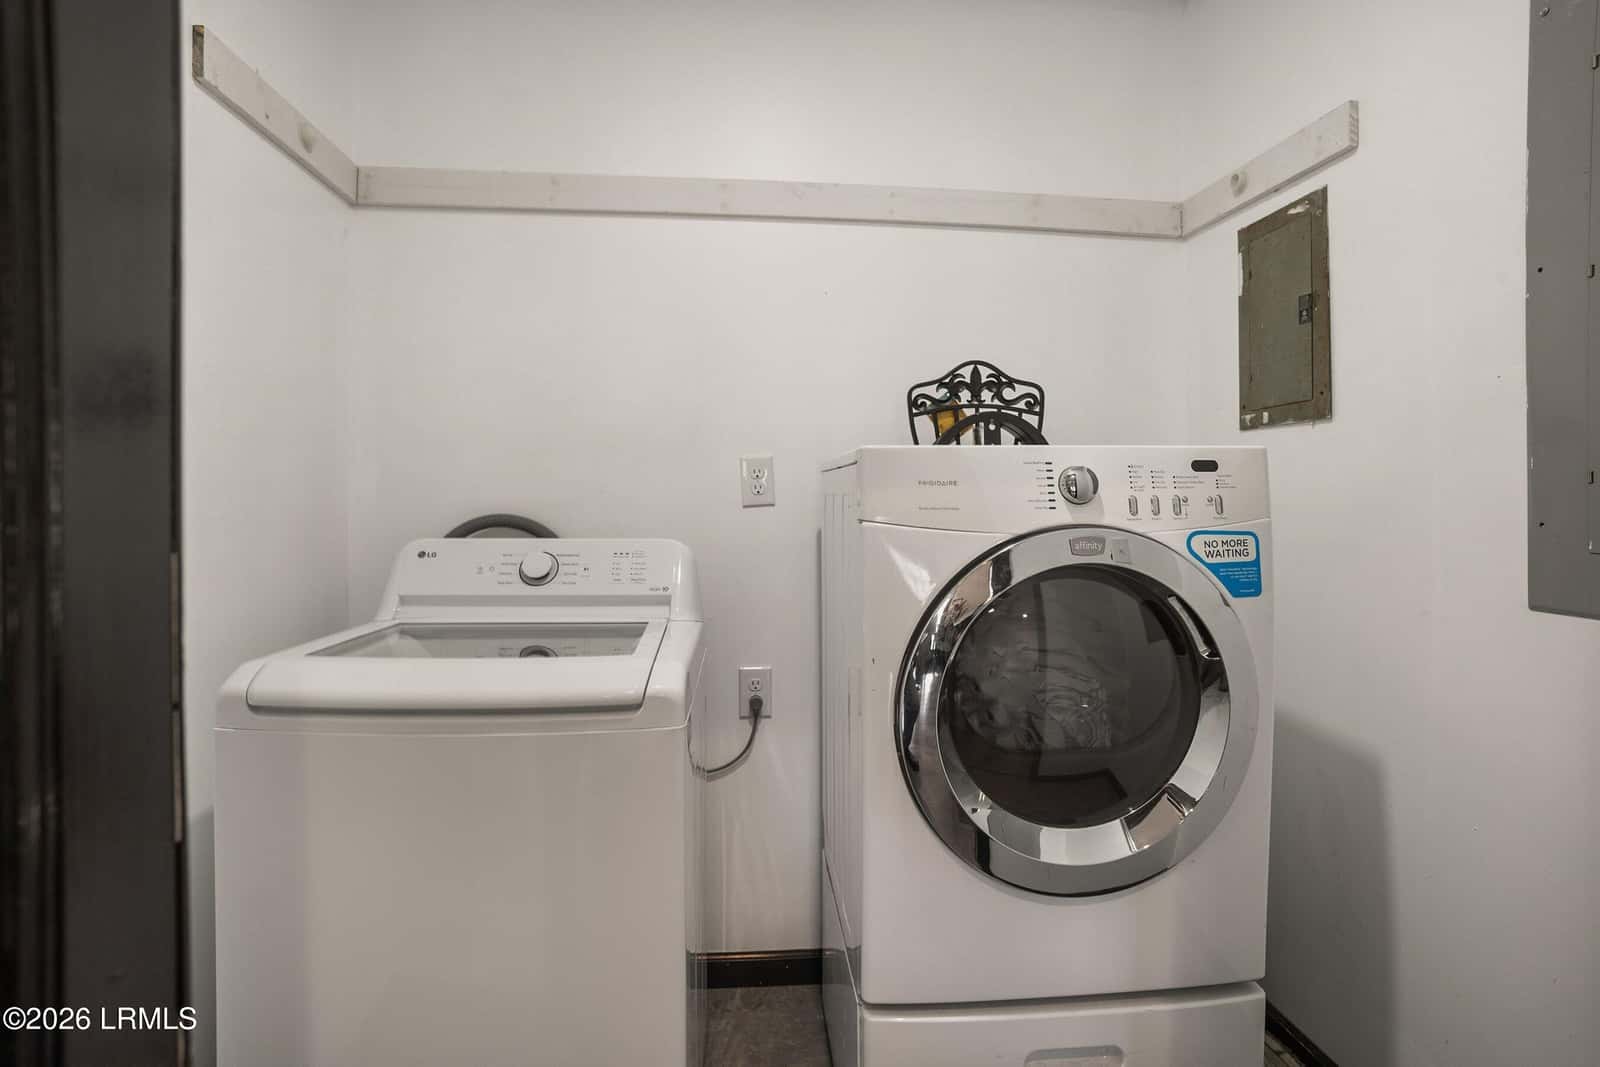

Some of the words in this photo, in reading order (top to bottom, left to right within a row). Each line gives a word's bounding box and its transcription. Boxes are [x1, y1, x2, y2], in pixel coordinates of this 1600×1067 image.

[1074, 541, 1105, 552] affinity
[1203, 540, 1219, 549] NO
[1221, 538, 1249, 548] MORE
[1204, 548, 1250, 559] WAITING
